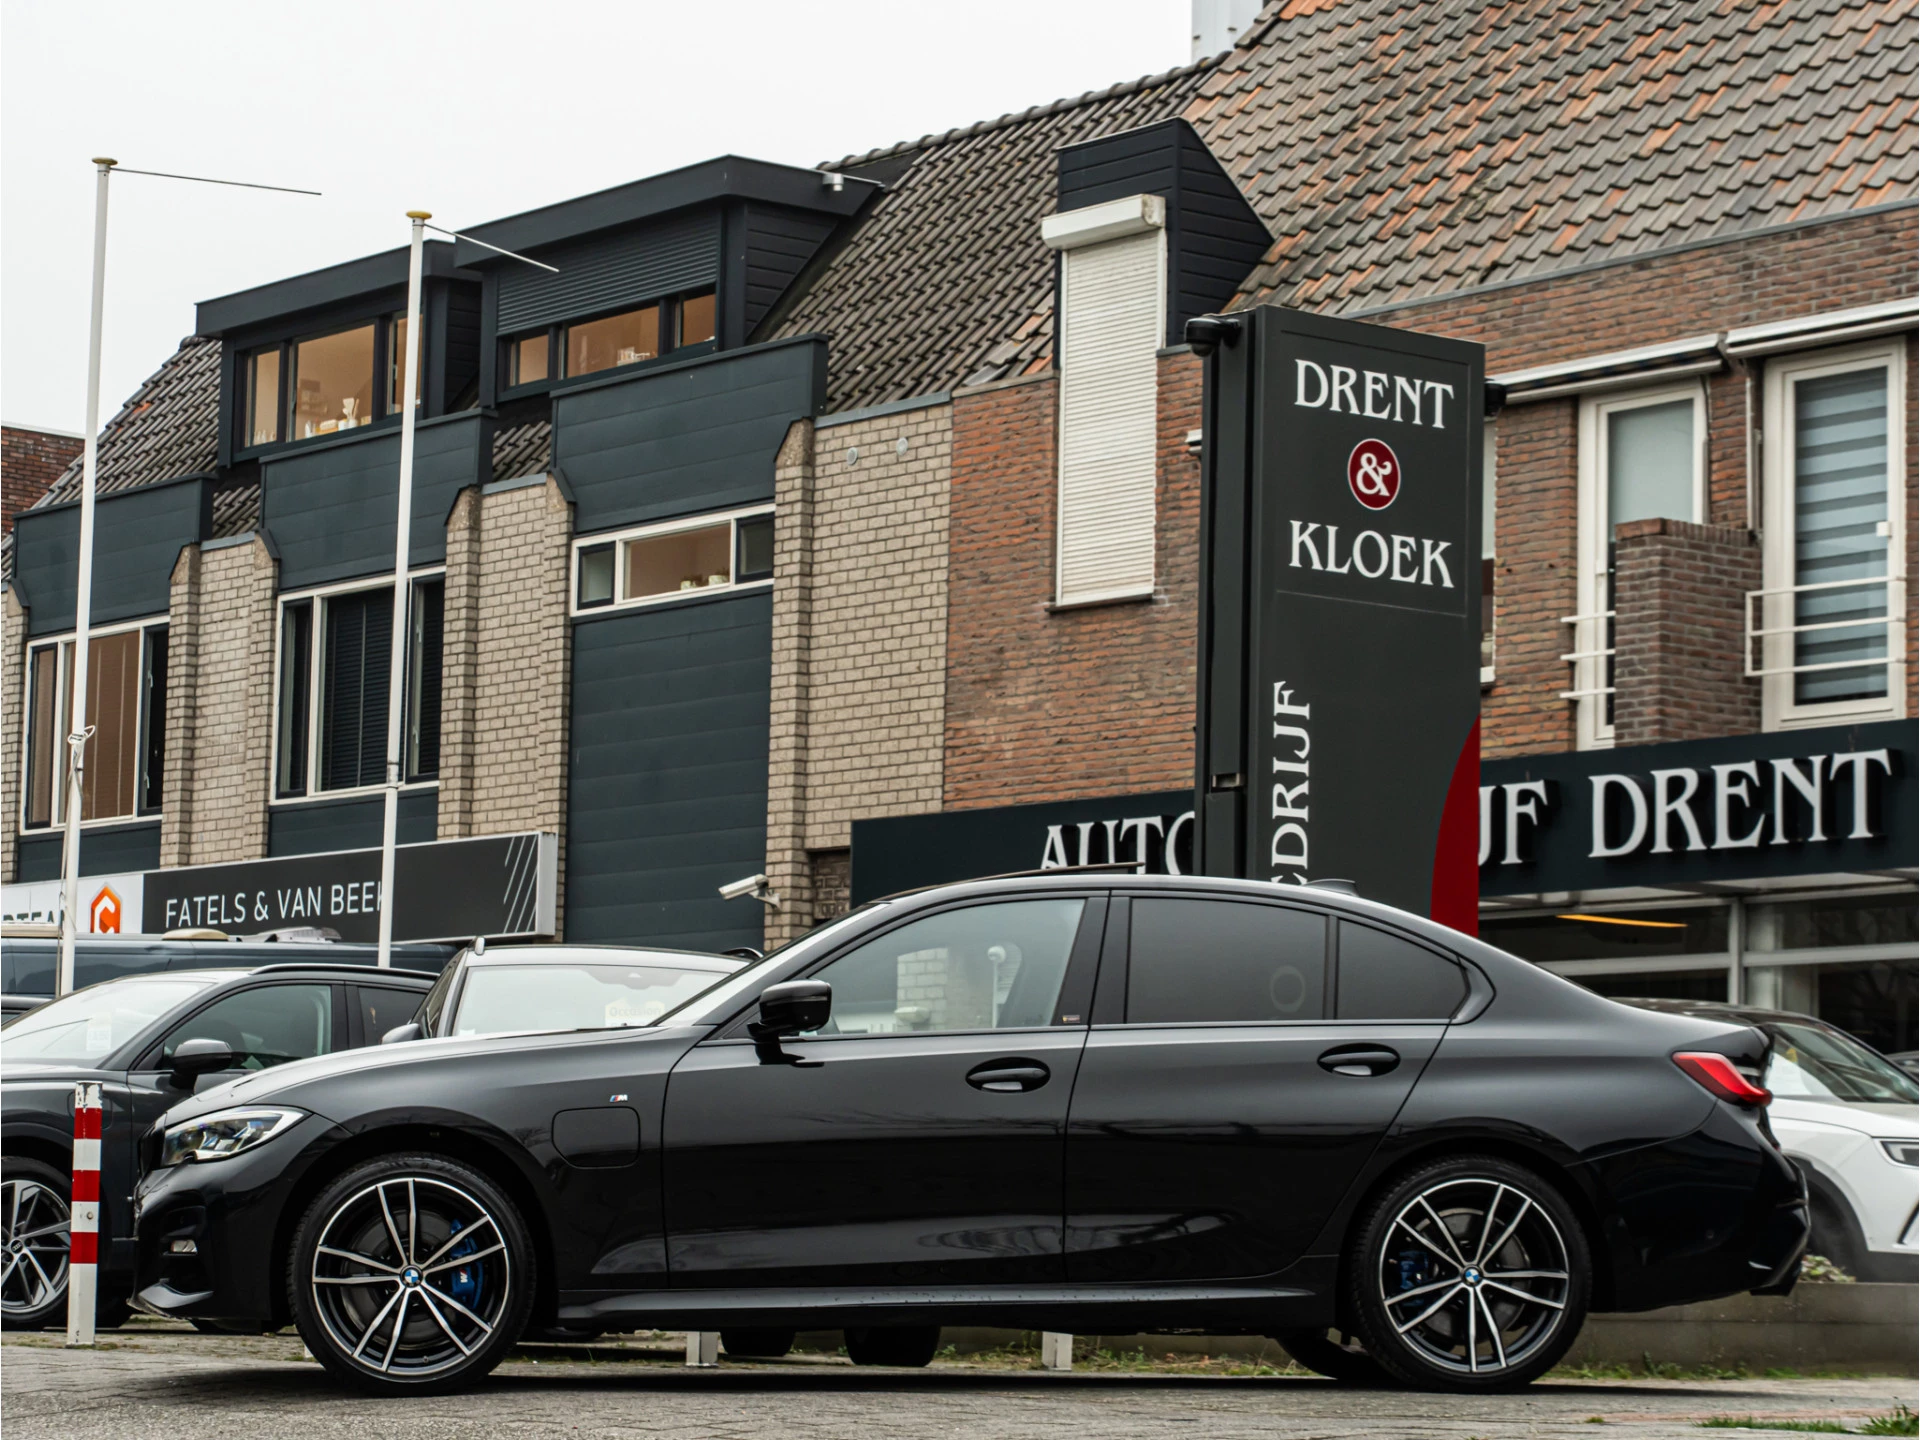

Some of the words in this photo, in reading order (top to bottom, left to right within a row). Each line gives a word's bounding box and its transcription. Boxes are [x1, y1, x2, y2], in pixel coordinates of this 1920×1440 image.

[1294, 358, 1455, 429] DRENT
[1355, 452, 1393, 497] &
[1289, 519, 1455, 588] KLOEK
[1271, 680, 1311, 885] DRIJF
[1588, 748, 1892, 858] DRENT
[165, 892, 247, 929] FATELS
[253, 890, 269, 922] &
[277, 885, 322, 920] VAN
